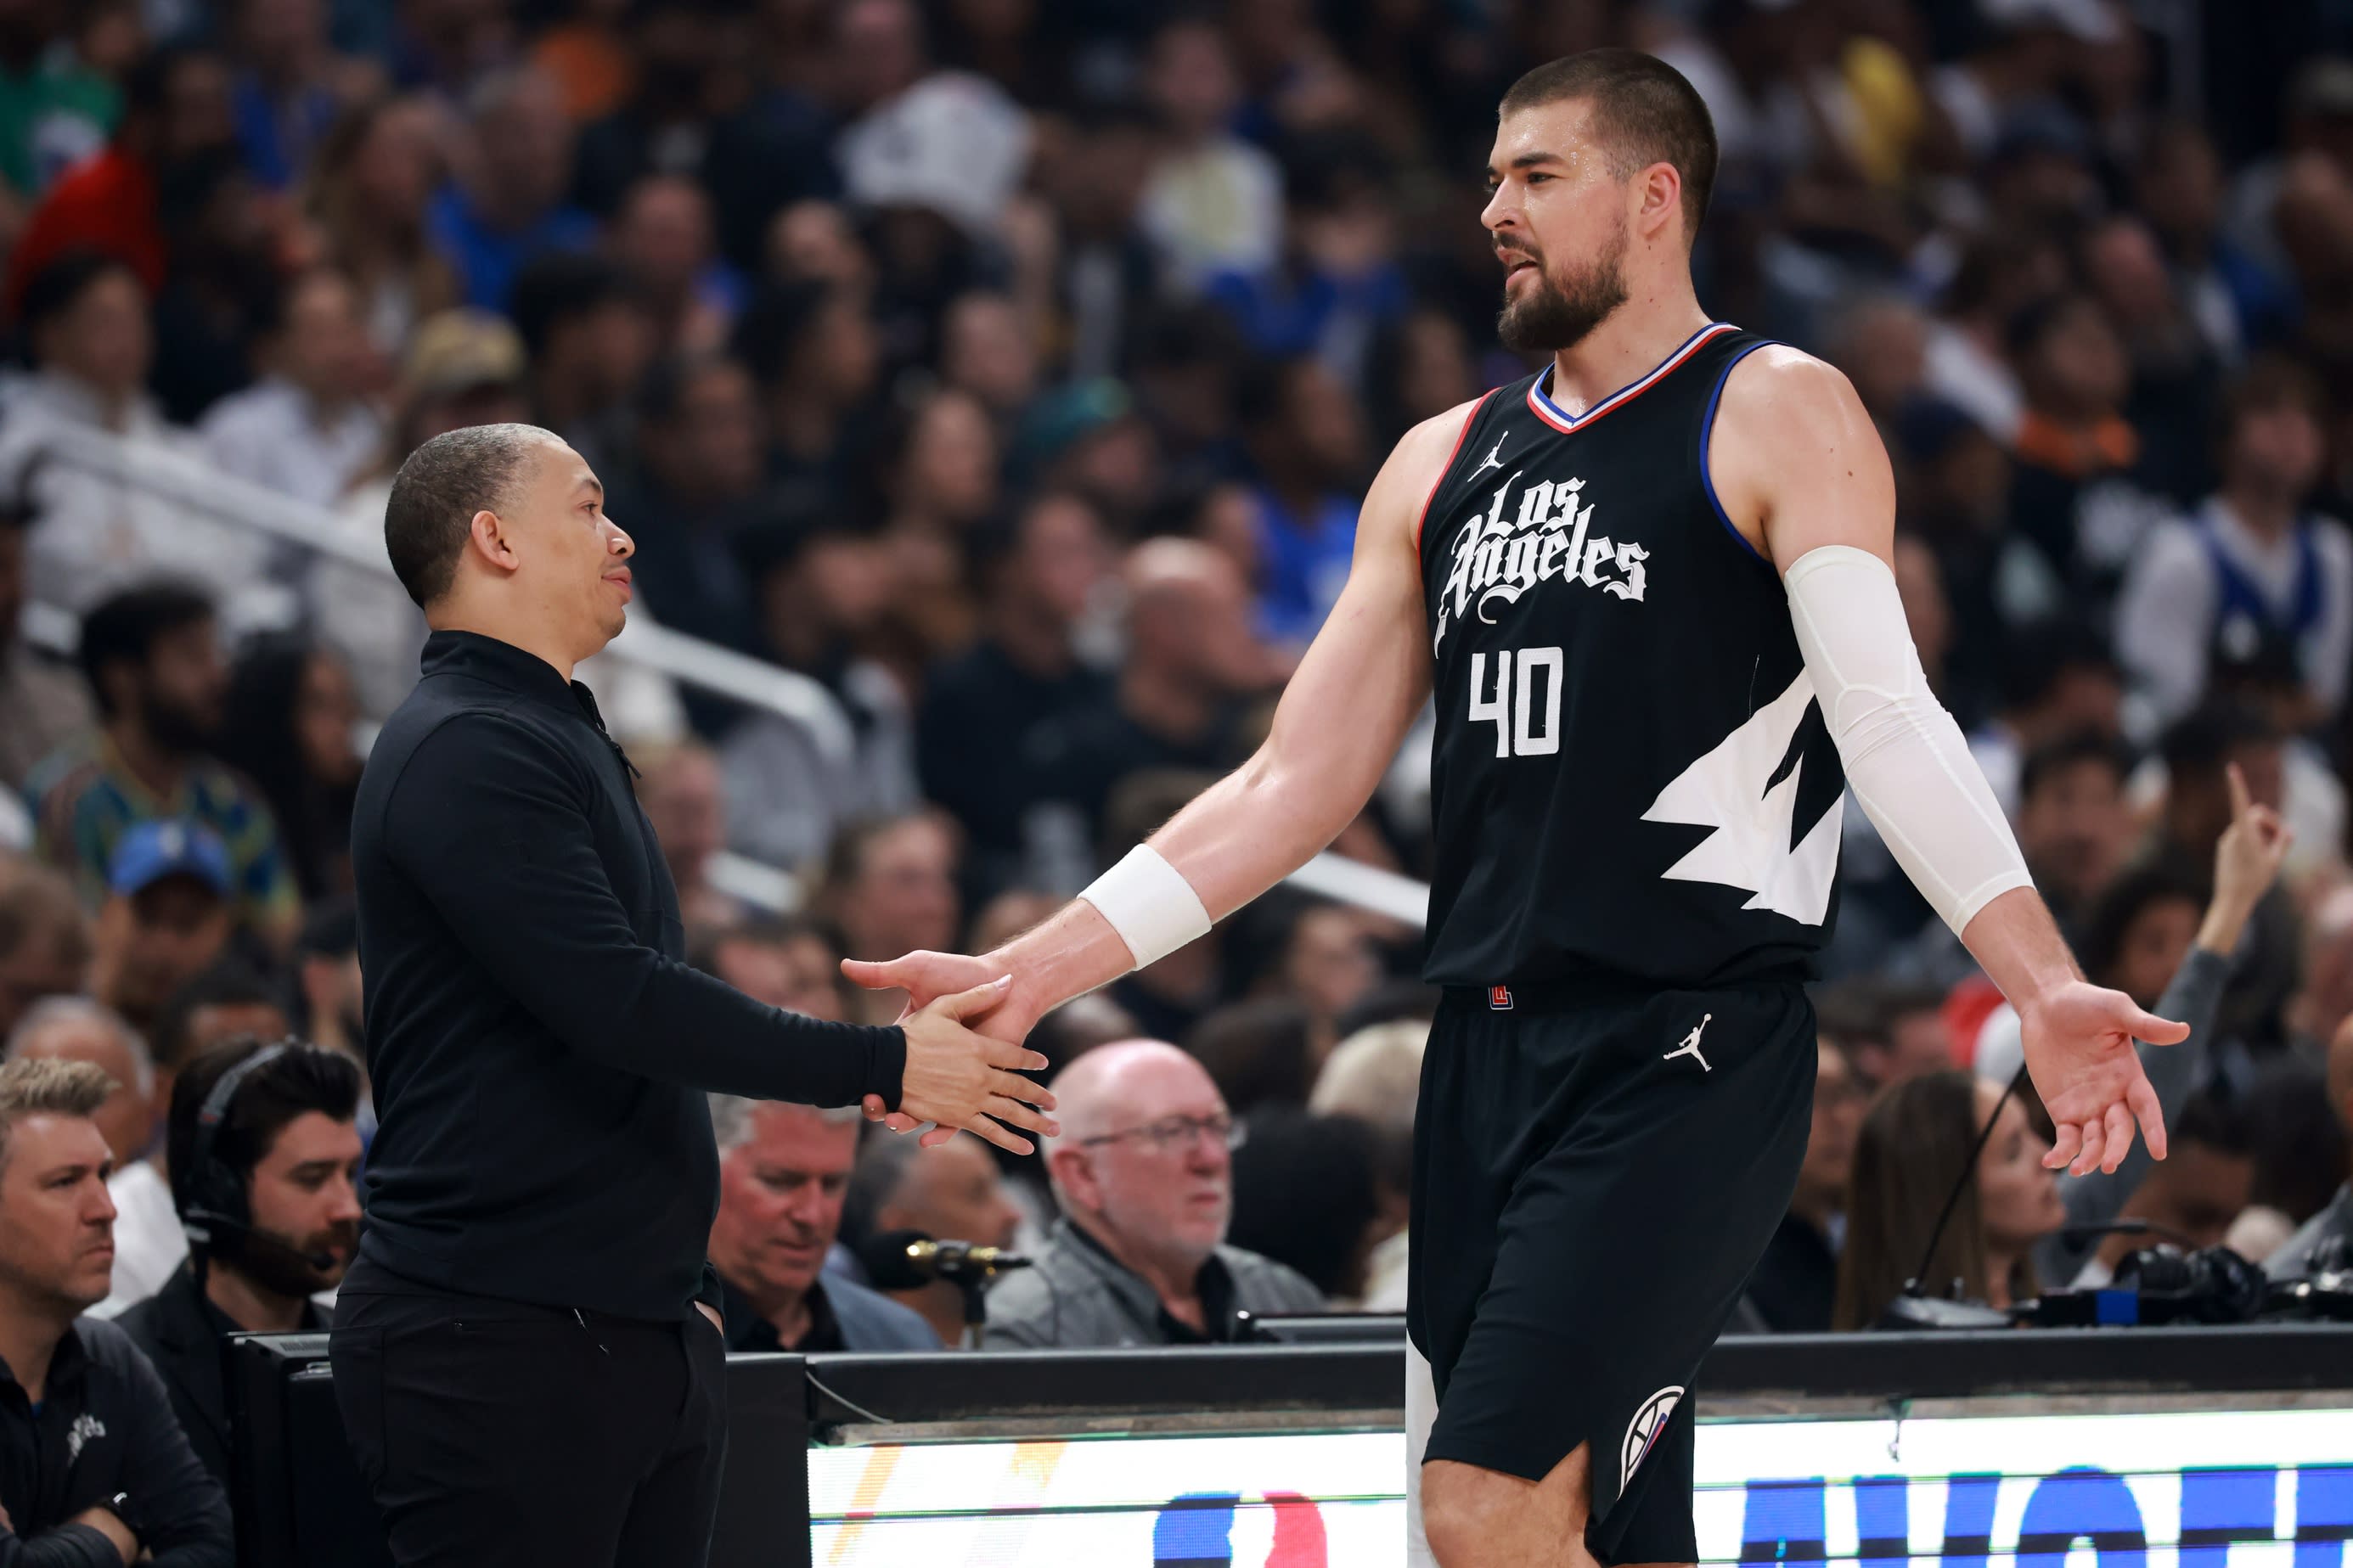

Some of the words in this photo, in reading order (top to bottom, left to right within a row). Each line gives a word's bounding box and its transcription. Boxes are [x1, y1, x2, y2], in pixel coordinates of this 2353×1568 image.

[1483, 470, 1586, 534] Los
[1434, 503, 1650, 658] Angeles
[1468, 646, 1563, 757] 40
